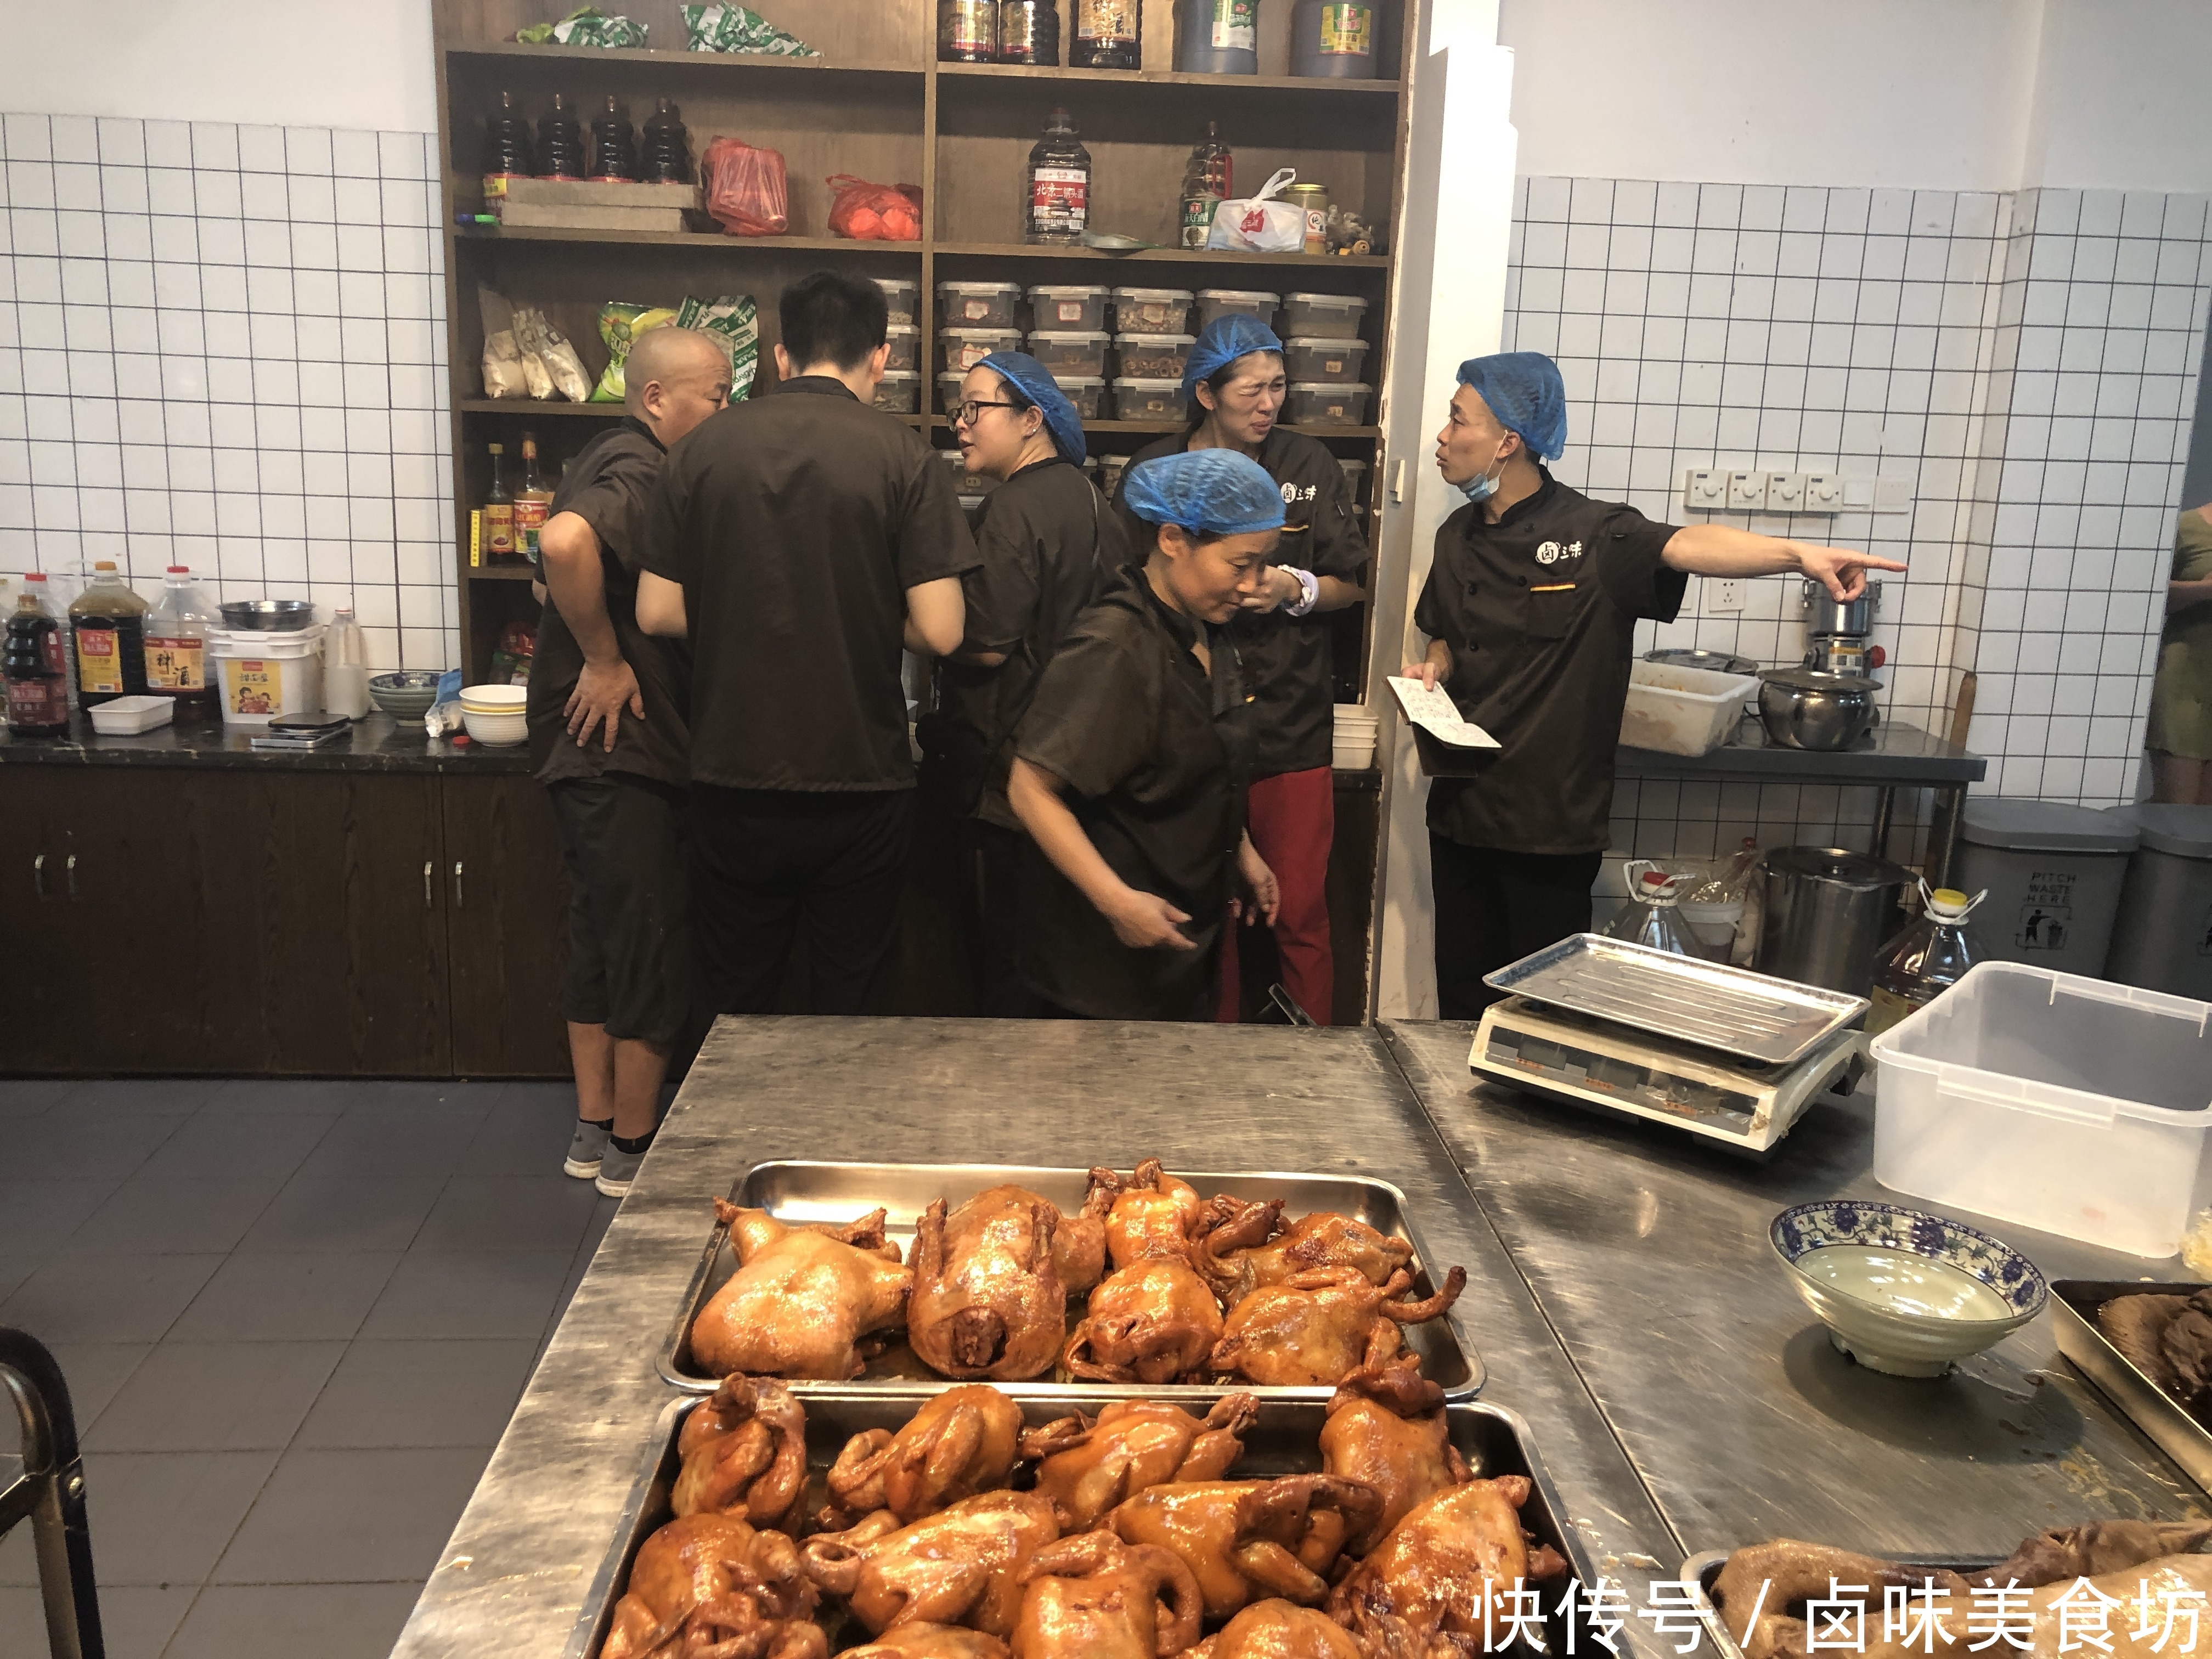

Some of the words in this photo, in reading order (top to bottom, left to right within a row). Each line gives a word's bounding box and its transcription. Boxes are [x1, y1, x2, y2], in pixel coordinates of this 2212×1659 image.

[1036, 182, 1084, 199] 北京二锅头酒
[2032, 872, 2076, 883] PITCH
[2029, 884, 2071, 894] WASTE
[2027, 895, 2070, 904] HERE
